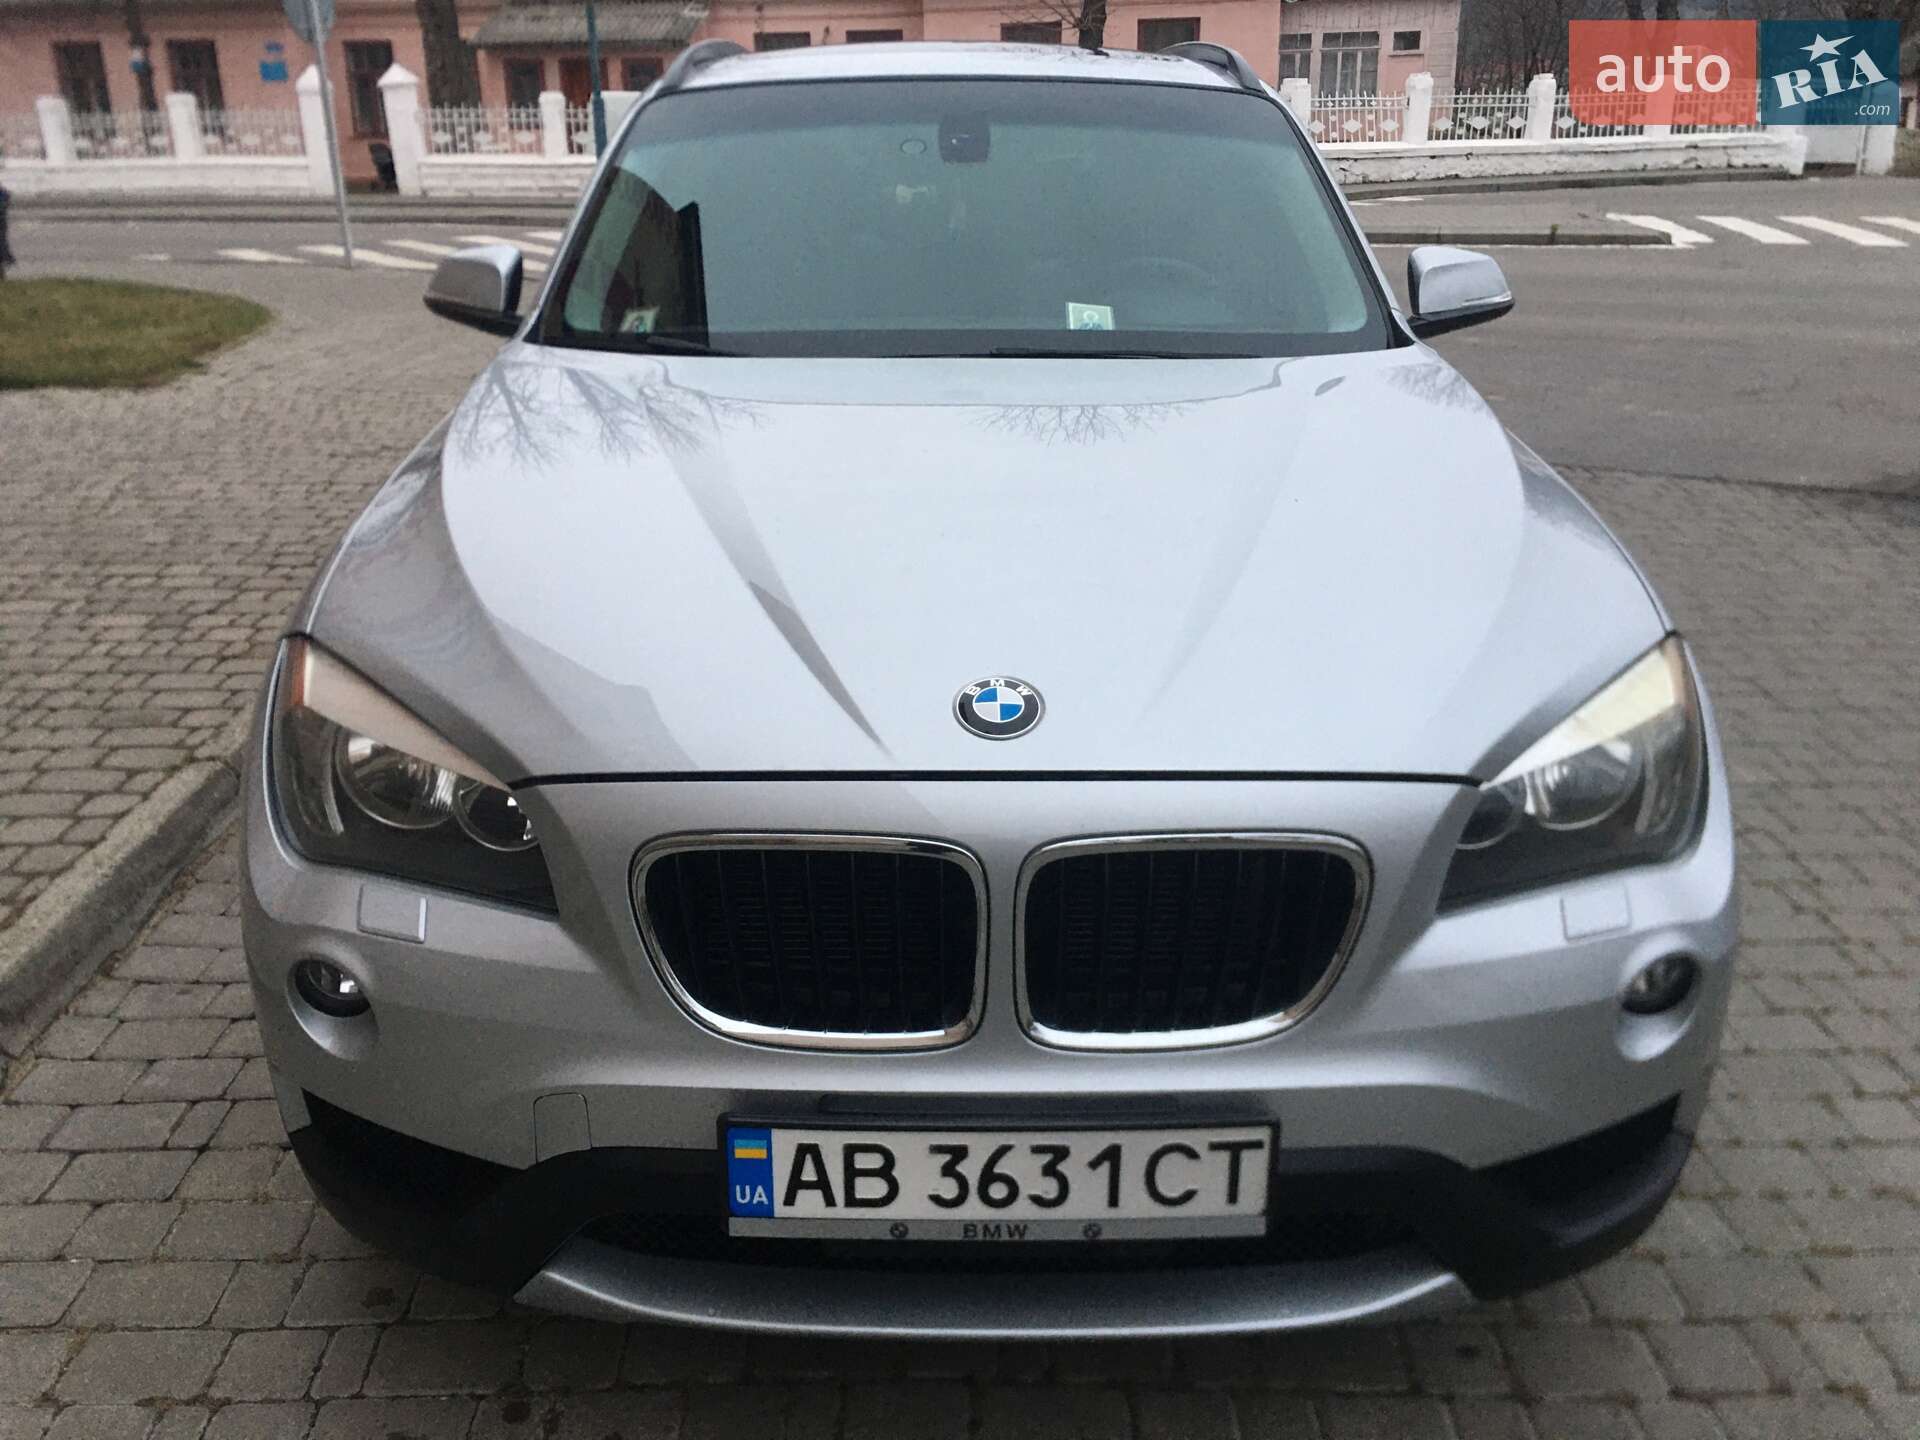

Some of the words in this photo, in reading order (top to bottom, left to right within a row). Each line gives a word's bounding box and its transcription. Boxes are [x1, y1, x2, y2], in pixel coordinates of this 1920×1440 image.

[966, 679, 1032, 696] BMW
[783, 1142, 900, 1208] AB
[928, 1144, 1122, 1208] 3631
[1144, 1139, 1264, 1206] CT
[736, 1184, 768, 1205] UA
[963, 1224, 1027, 1239] BMW
